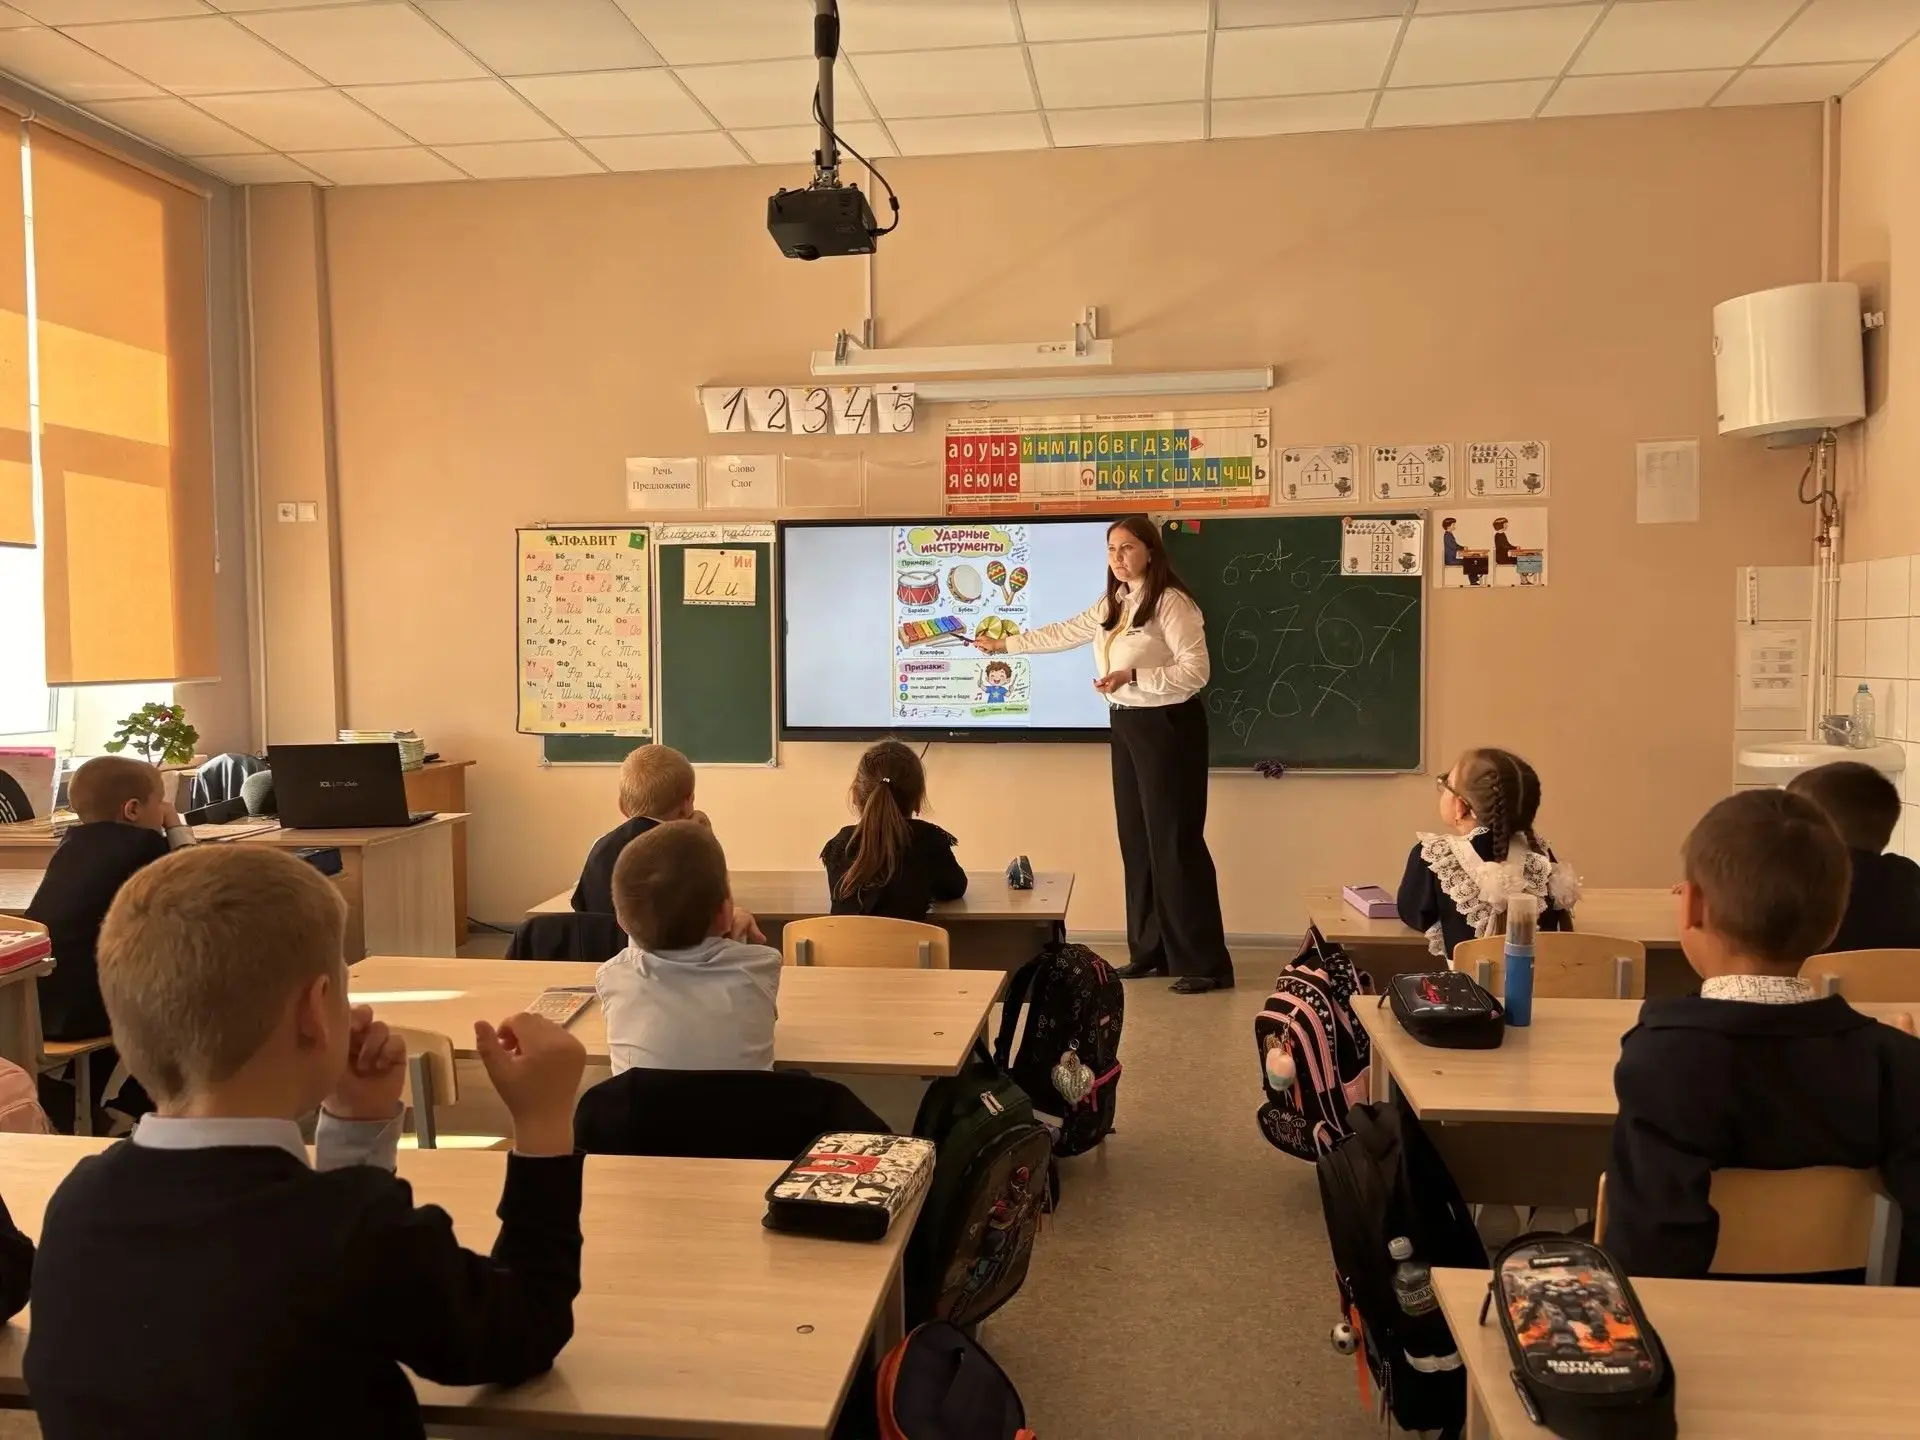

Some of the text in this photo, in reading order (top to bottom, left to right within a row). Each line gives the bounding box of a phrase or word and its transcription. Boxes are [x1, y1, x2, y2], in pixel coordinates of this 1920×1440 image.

[723, 386, 915, 433] 1 2 3 4 5
[949, 435, 1188, 462] а о у ы э й н м л р б в г д з ж
[652, 467, 673, 476] Речь
[728, 464, 756, 473] Слово
[949, 465, 1251, 489] я ё ю и е п ф к т с ш х ц ч щ
[632, 481, 691, 491] Предложение
[731, 479, 753, 488] Слог
[722, 525, 774, 540] работа
[934, 528, 990, 546] Ударные
[551, 535, 617, 546] АЛФАВИТ
[921, 542, 1004, 556] инструменты
[901, 559, 933, 567] Примеры:
[905, 664, 945, 672] Признаки:
